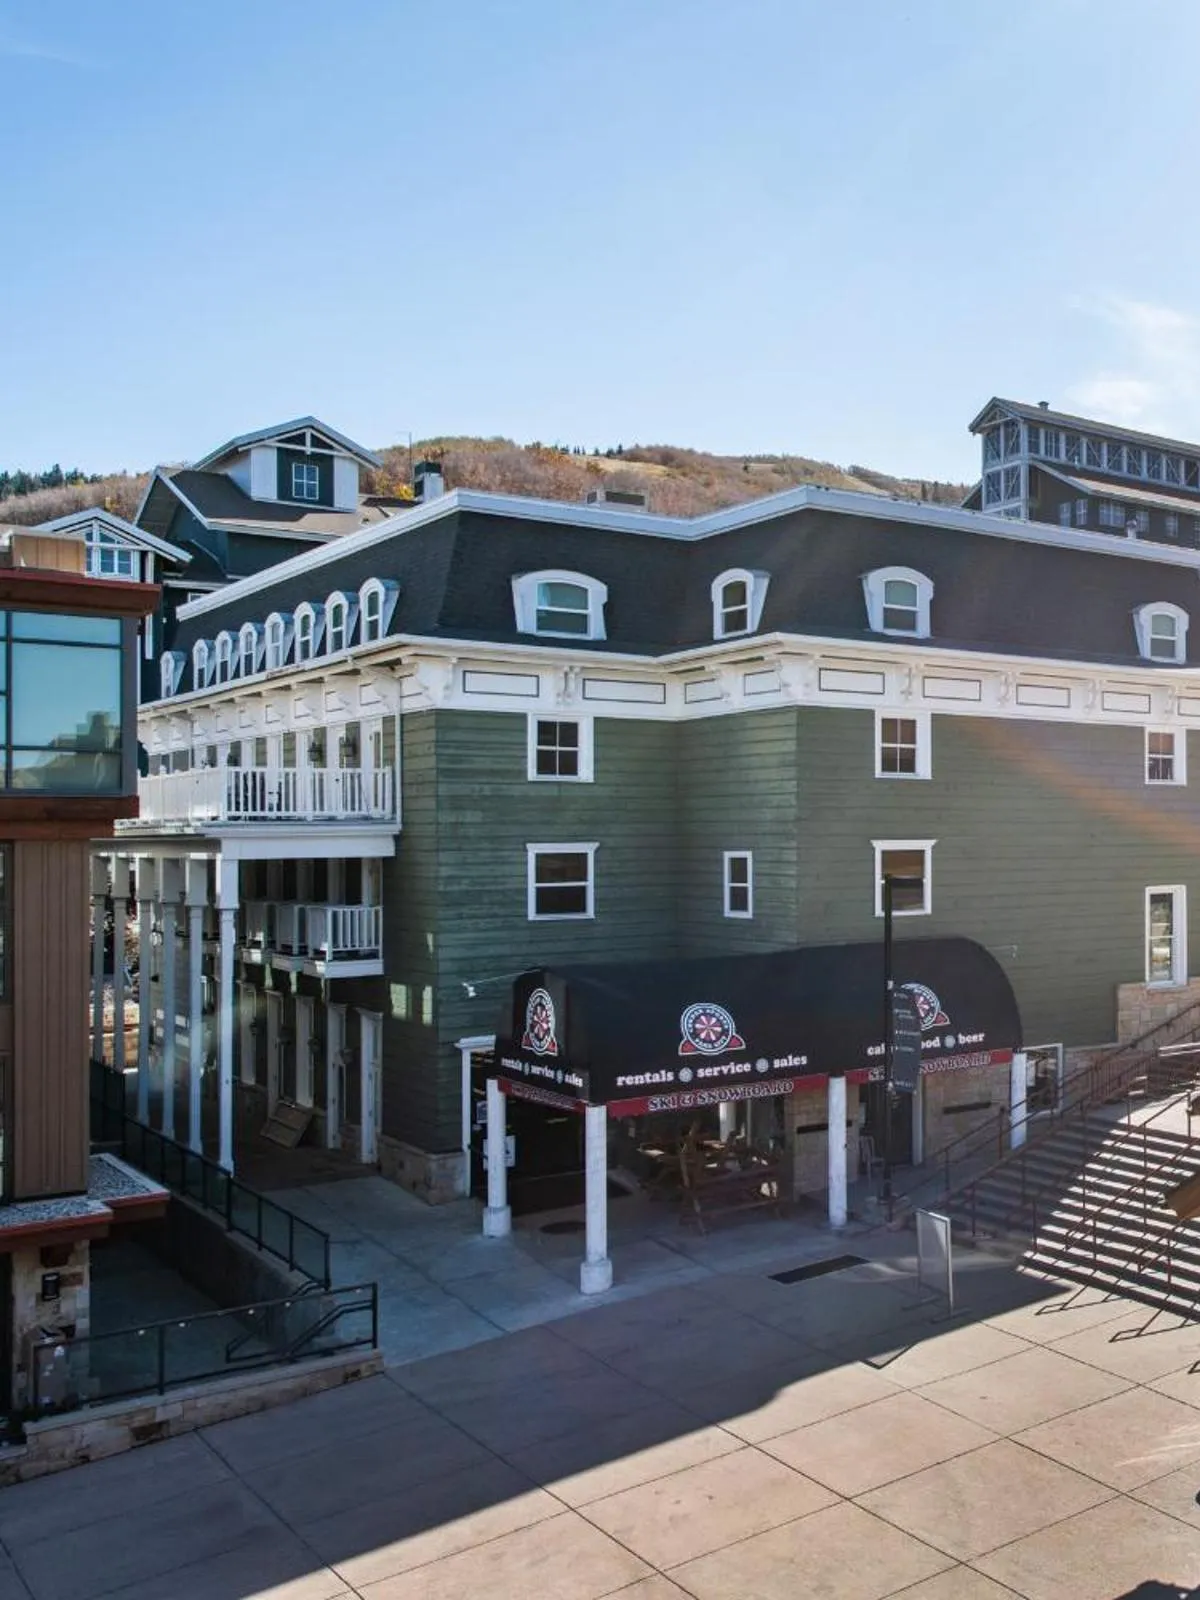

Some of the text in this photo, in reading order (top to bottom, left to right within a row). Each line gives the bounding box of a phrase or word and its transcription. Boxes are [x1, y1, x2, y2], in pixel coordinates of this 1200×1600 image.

[957, 1032, 986, 1045] beer
[615, 1054, 808, 1086] rentals service sales
[649, 1094, 678, 1111] SKI
[696, 1079, 795, 1106] SNOWBOARD
